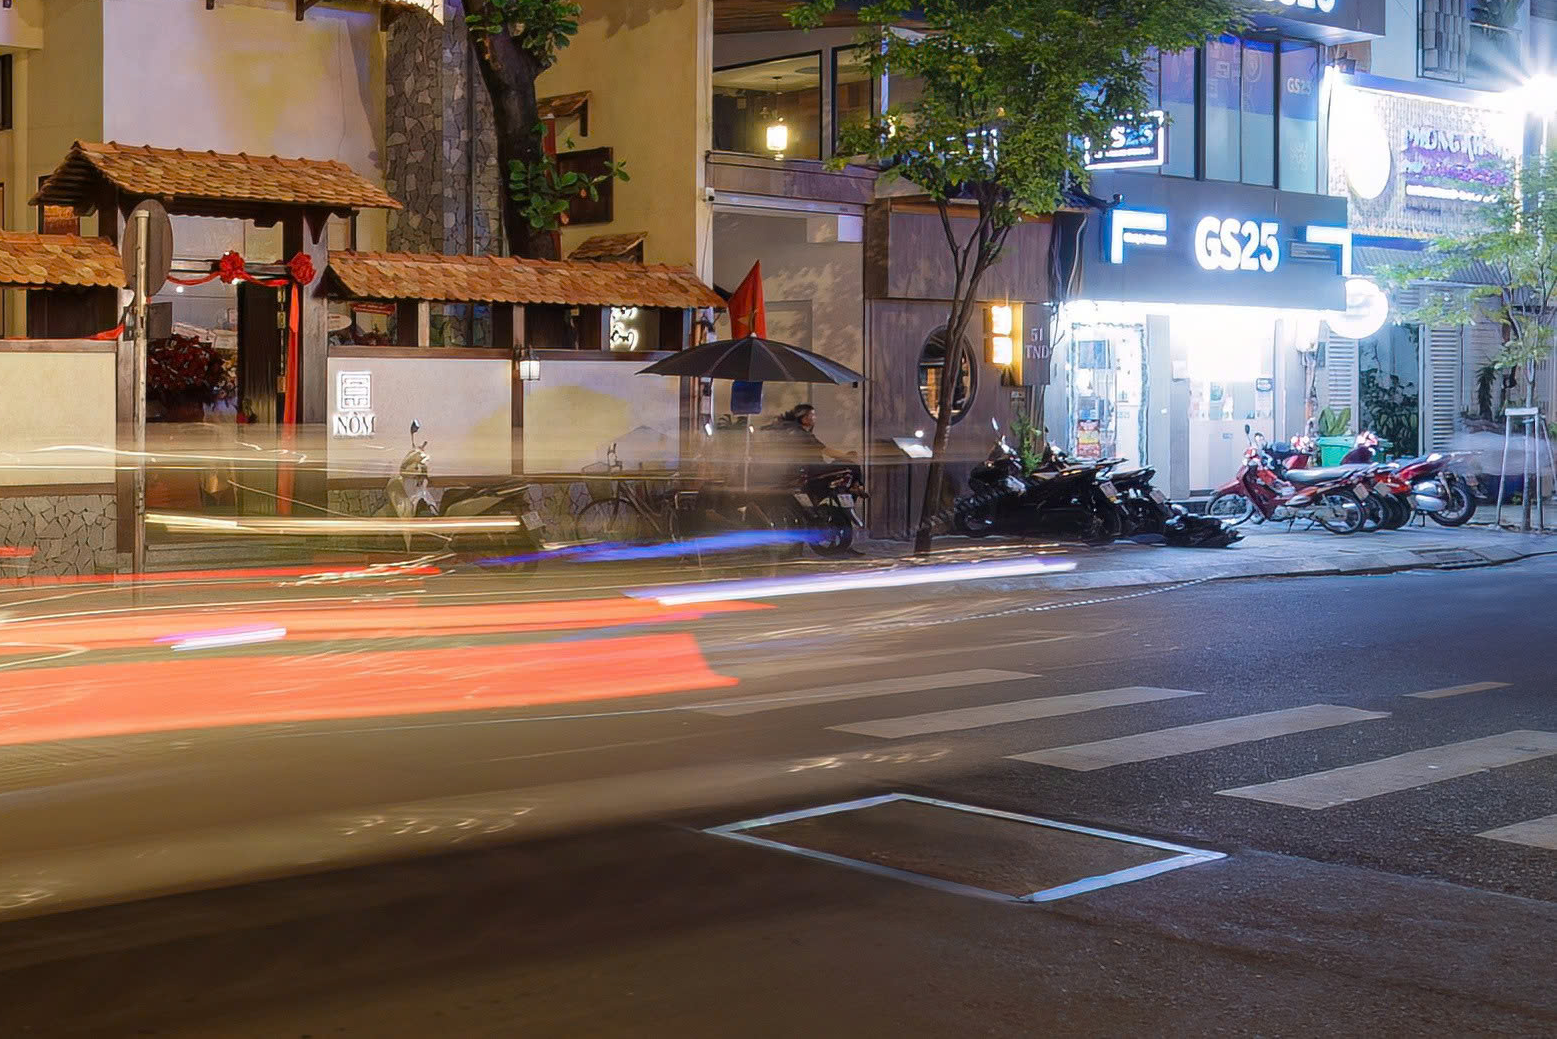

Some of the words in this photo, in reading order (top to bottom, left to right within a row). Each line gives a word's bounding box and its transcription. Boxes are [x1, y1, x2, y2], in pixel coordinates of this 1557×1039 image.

[1195, 216, 1280, 272] GS25
[1031, 327, 1043, 342] 51
[1026, 344, 1050, 359] TND
